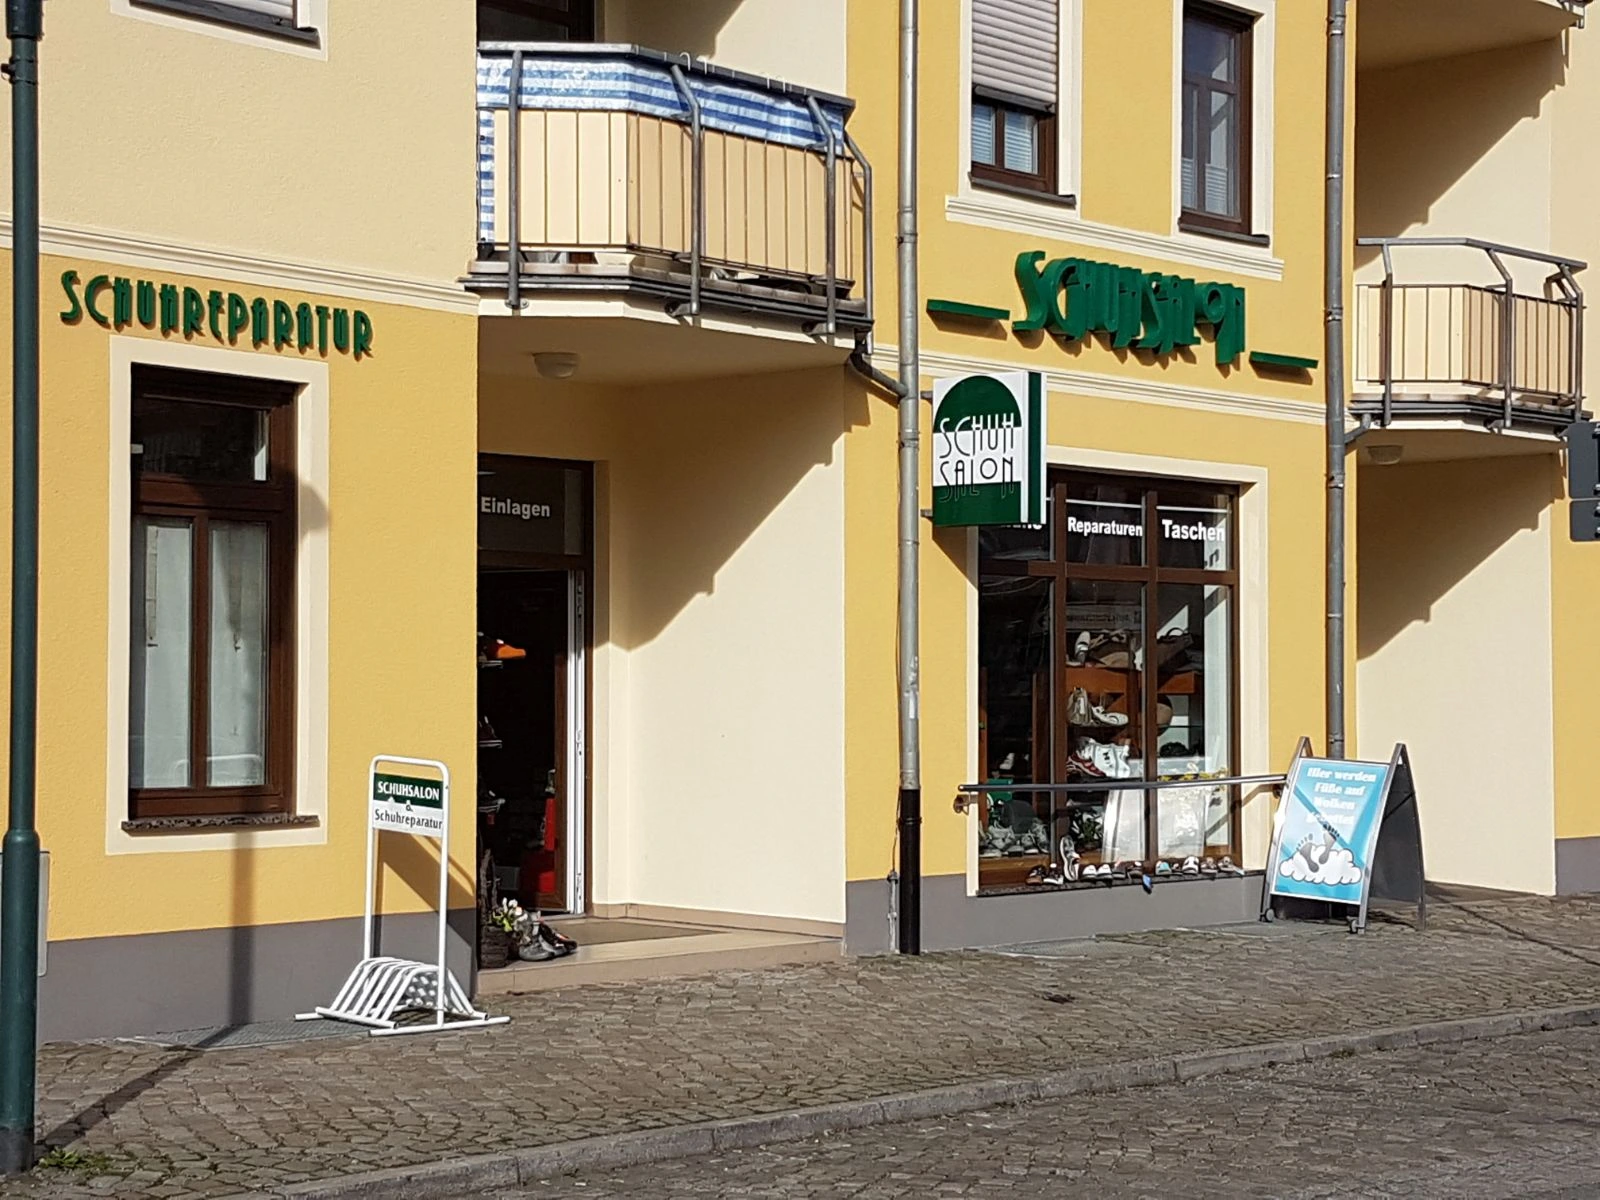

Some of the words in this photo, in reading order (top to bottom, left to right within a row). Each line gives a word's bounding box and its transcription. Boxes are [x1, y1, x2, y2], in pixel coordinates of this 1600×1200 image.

[60, 270, 373, 356] SCHUHREPARATUR
[939, 412, 1015, 458] SCHUH
[939, 456, 1015, 502] SALON
[481, 496, 551, 520] Einlagen
[1067, 516, 1143, 537] Reparaturen
[1161, 518, 1226, 542] Taschen
[1334, 771, 1377, 782] werden
[377, 780, 440, 801] SCHUHSALON
[374, 808, 443, 830] Schuhreparatur
